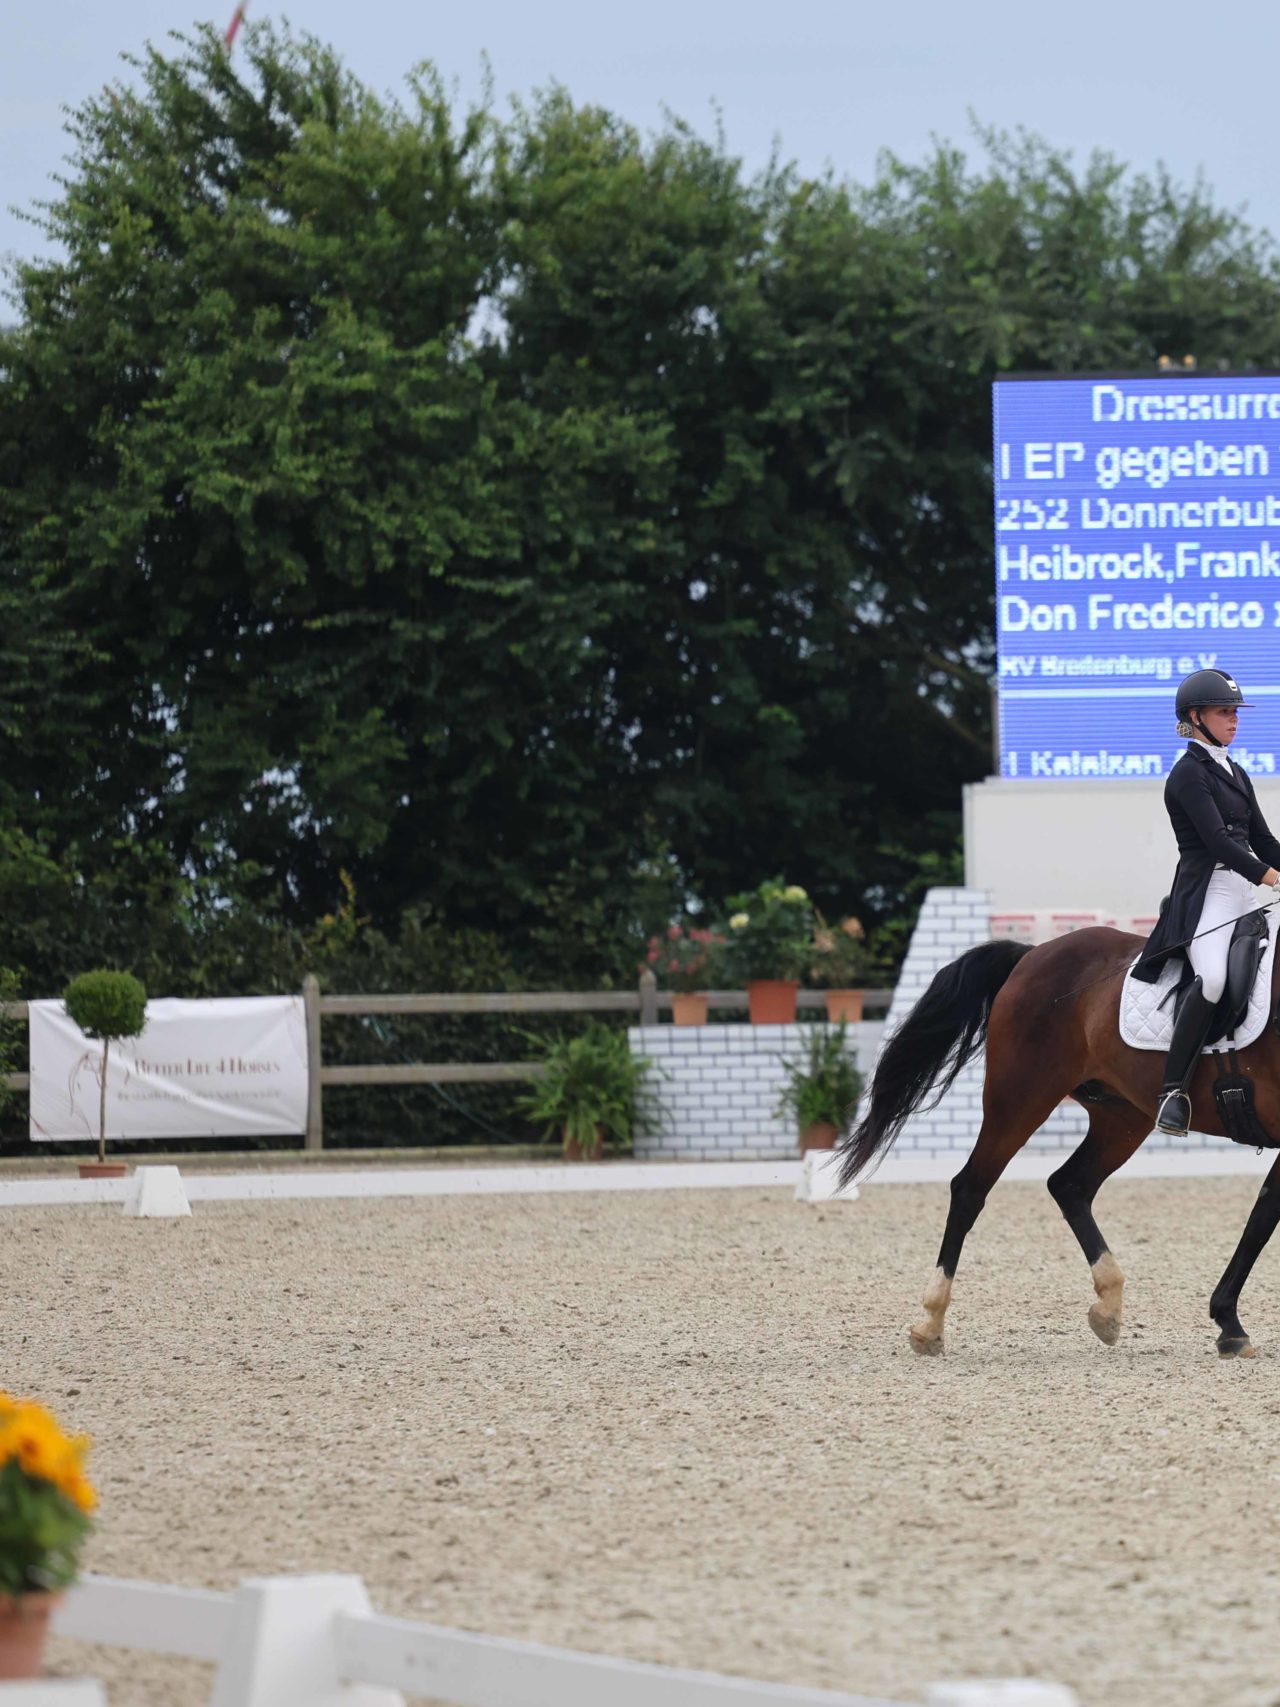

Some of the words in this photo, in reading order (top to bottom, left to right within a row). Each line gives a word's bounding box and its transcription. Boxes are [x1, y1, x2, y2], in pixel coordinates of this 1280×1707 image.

[1025, 441, 1085, 480] EP
[1096, 440, 1269, 490] gegeben
[998, 498, 1069, 531] 252
[1000, 595, 1077, 632] Don
